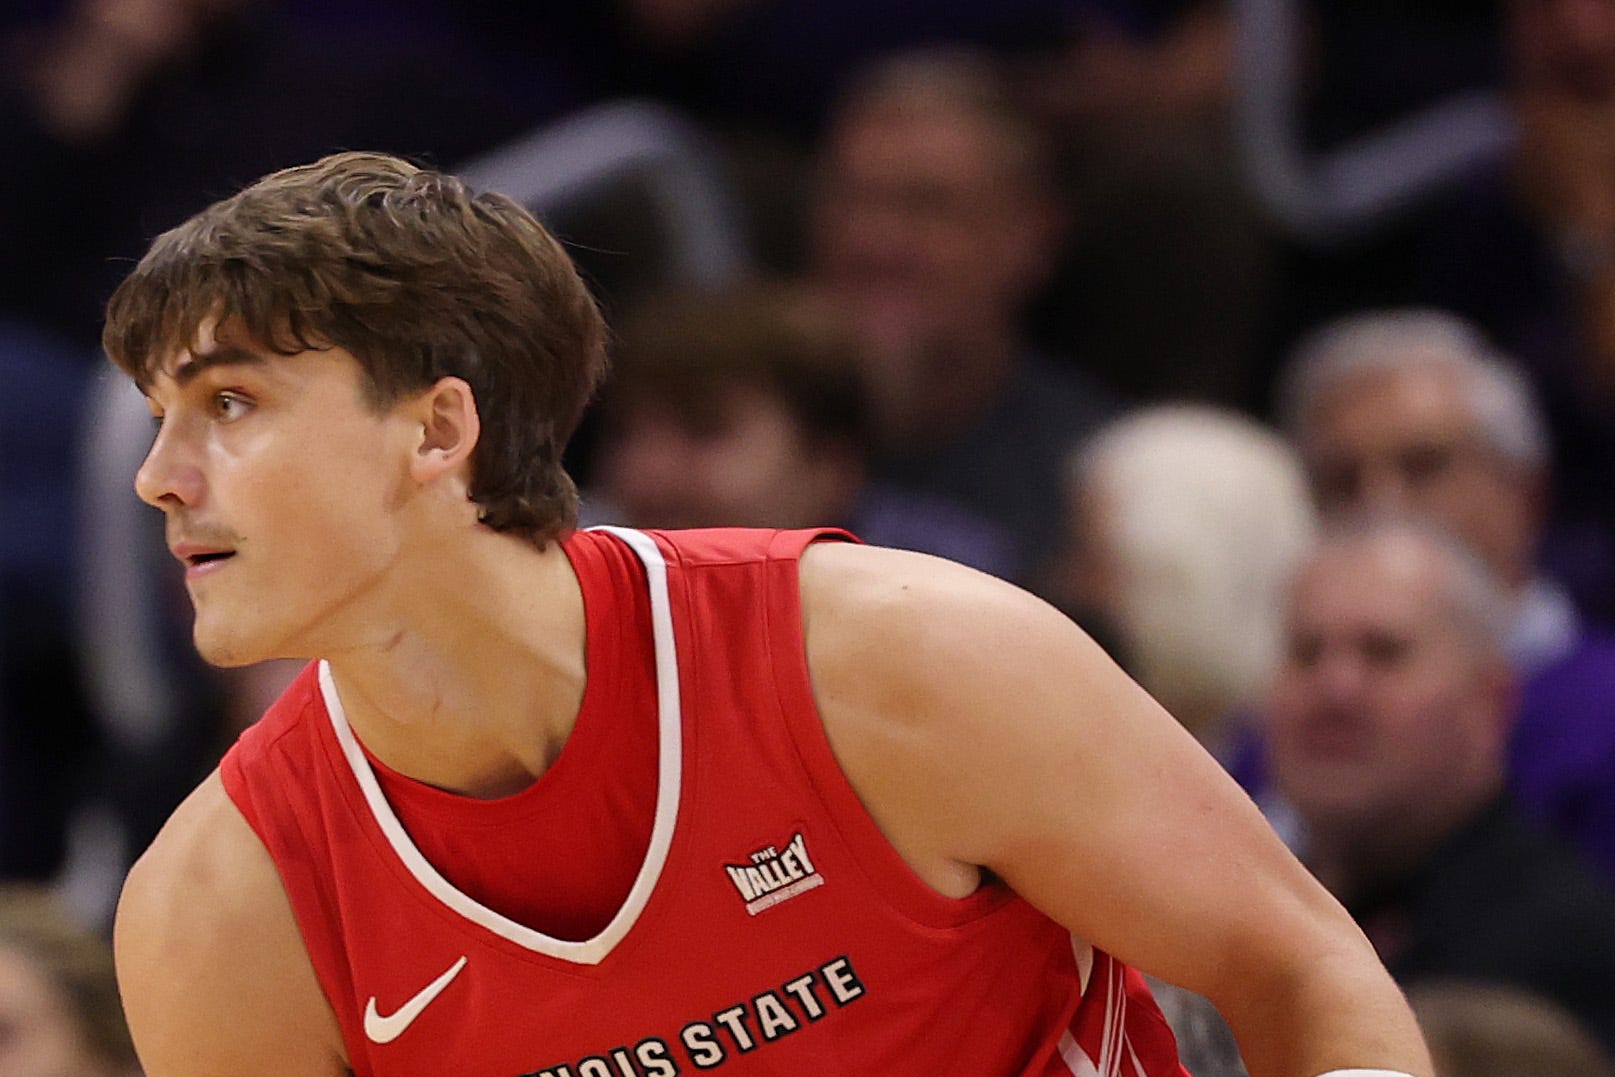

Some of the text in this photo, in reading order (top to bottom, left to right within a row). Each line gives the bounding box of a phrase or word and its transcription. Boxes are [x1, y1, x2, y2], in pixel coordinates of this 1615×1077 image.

[724, 832, 815, 903] VALLEY
[749, 846, 778, 864] THE
[680, 954, 867, 1072] STATE
